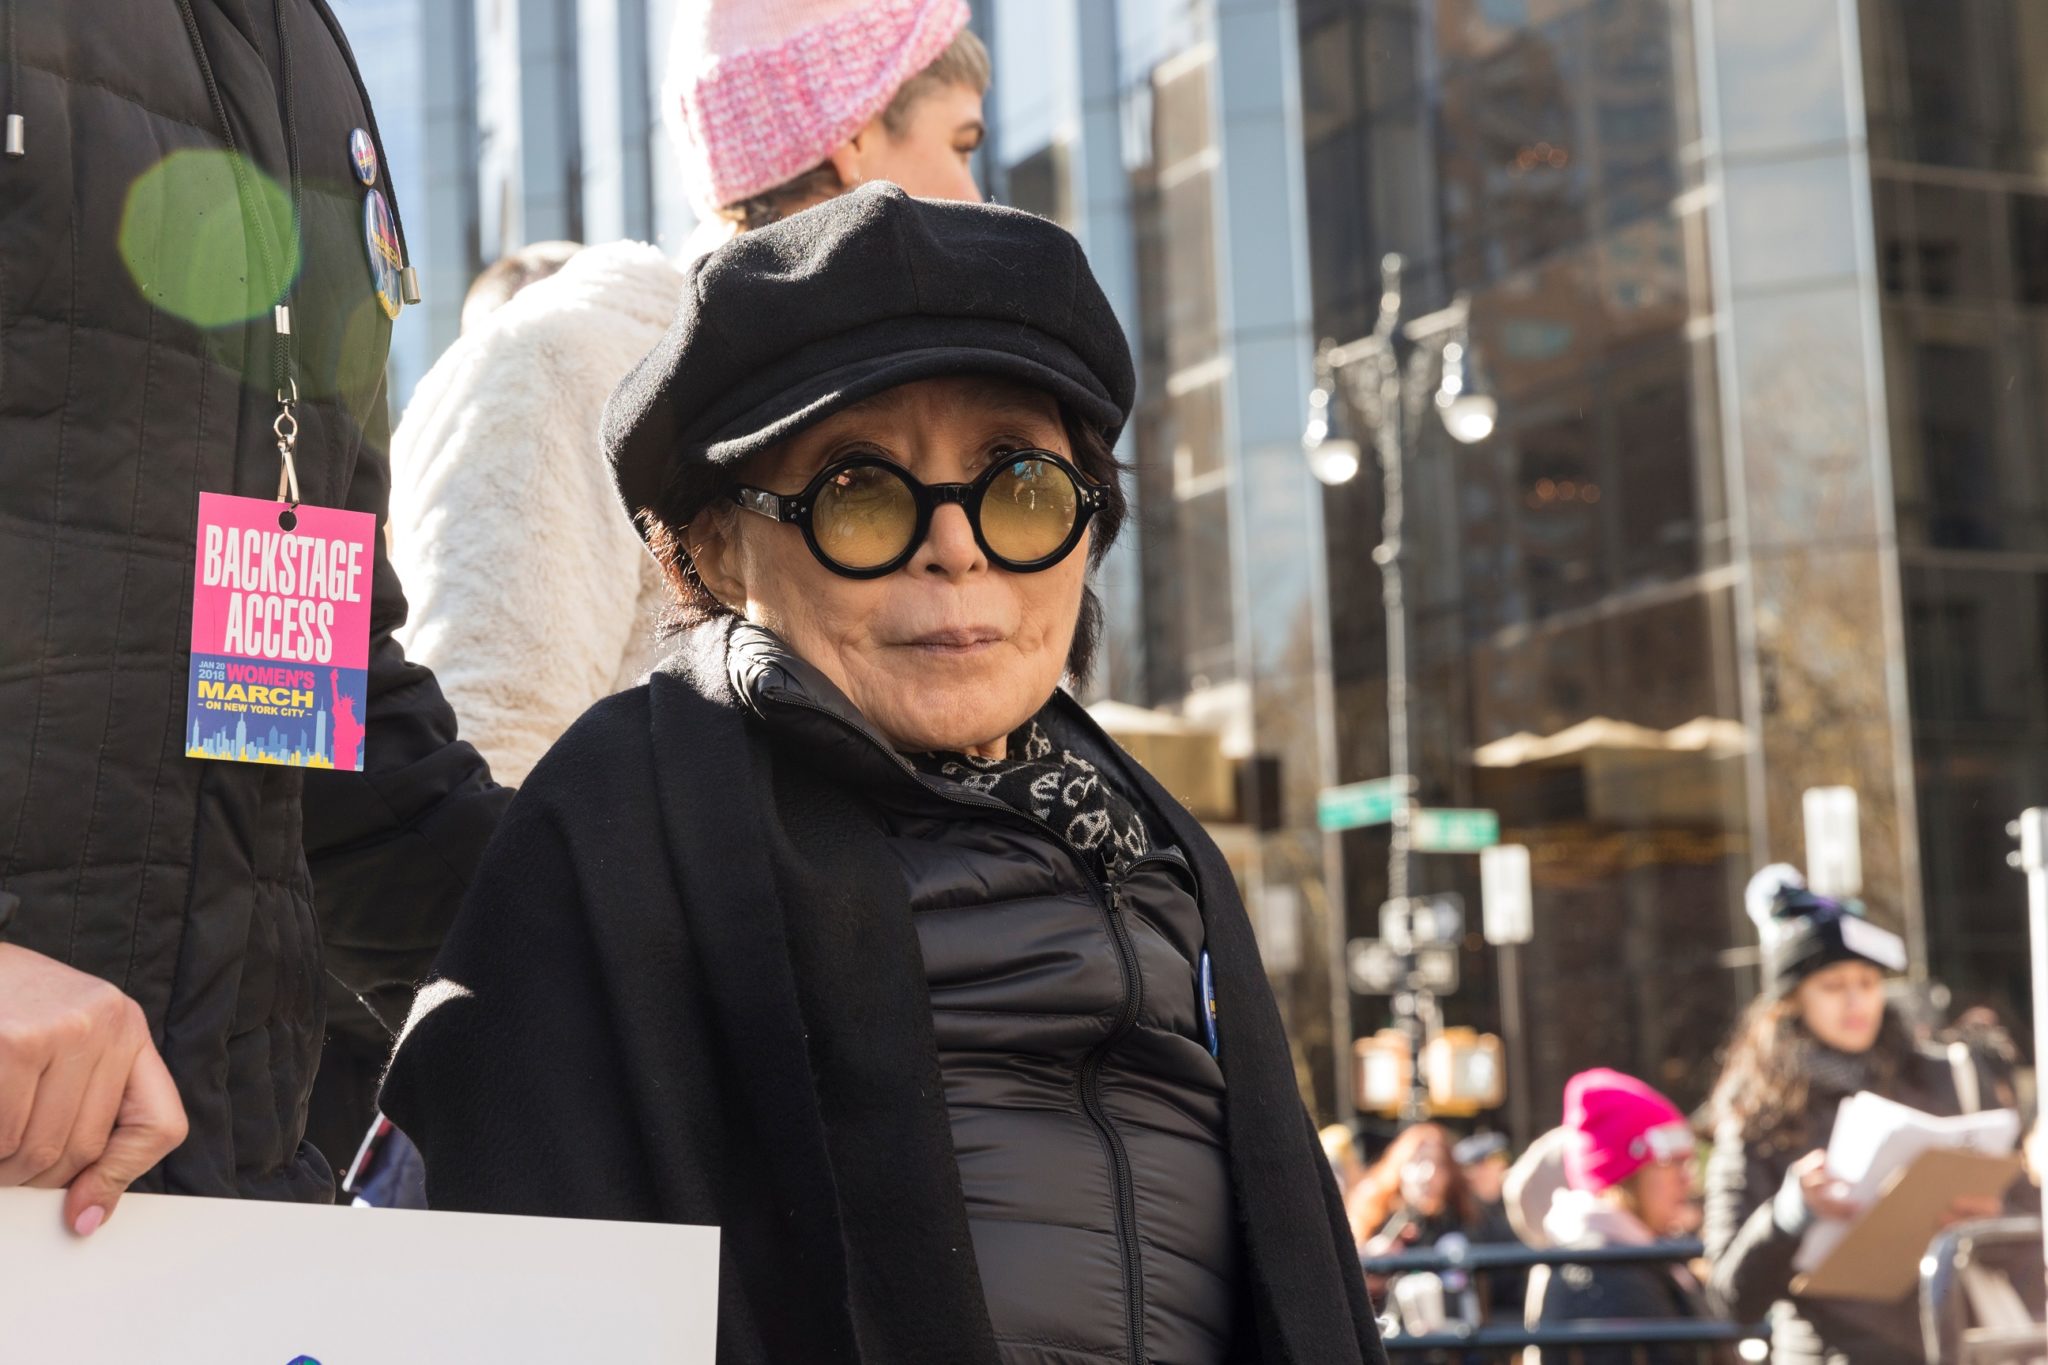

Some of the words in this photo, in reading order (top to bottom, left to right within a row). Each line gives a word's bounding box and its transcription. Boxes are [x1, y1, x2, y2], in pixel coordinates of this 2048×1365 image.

[203, 524, 363, 603] BACKSTAGE
[223, 592, 334, 663] ACCESS
[198, 660, 215, 669] JAN
[216, 662, 226, 670] 20
[198, 669, 225, 681] 2018
[226, 663, 315, 689] WOMEN'S
[197, 680, 314, 708] MARCH
[205, 701, 221, 710] ON
[224, 702, 247, 713] NEW
[250, 705, 278, 716] YORK
[281, 707, 305, 718] CITY
